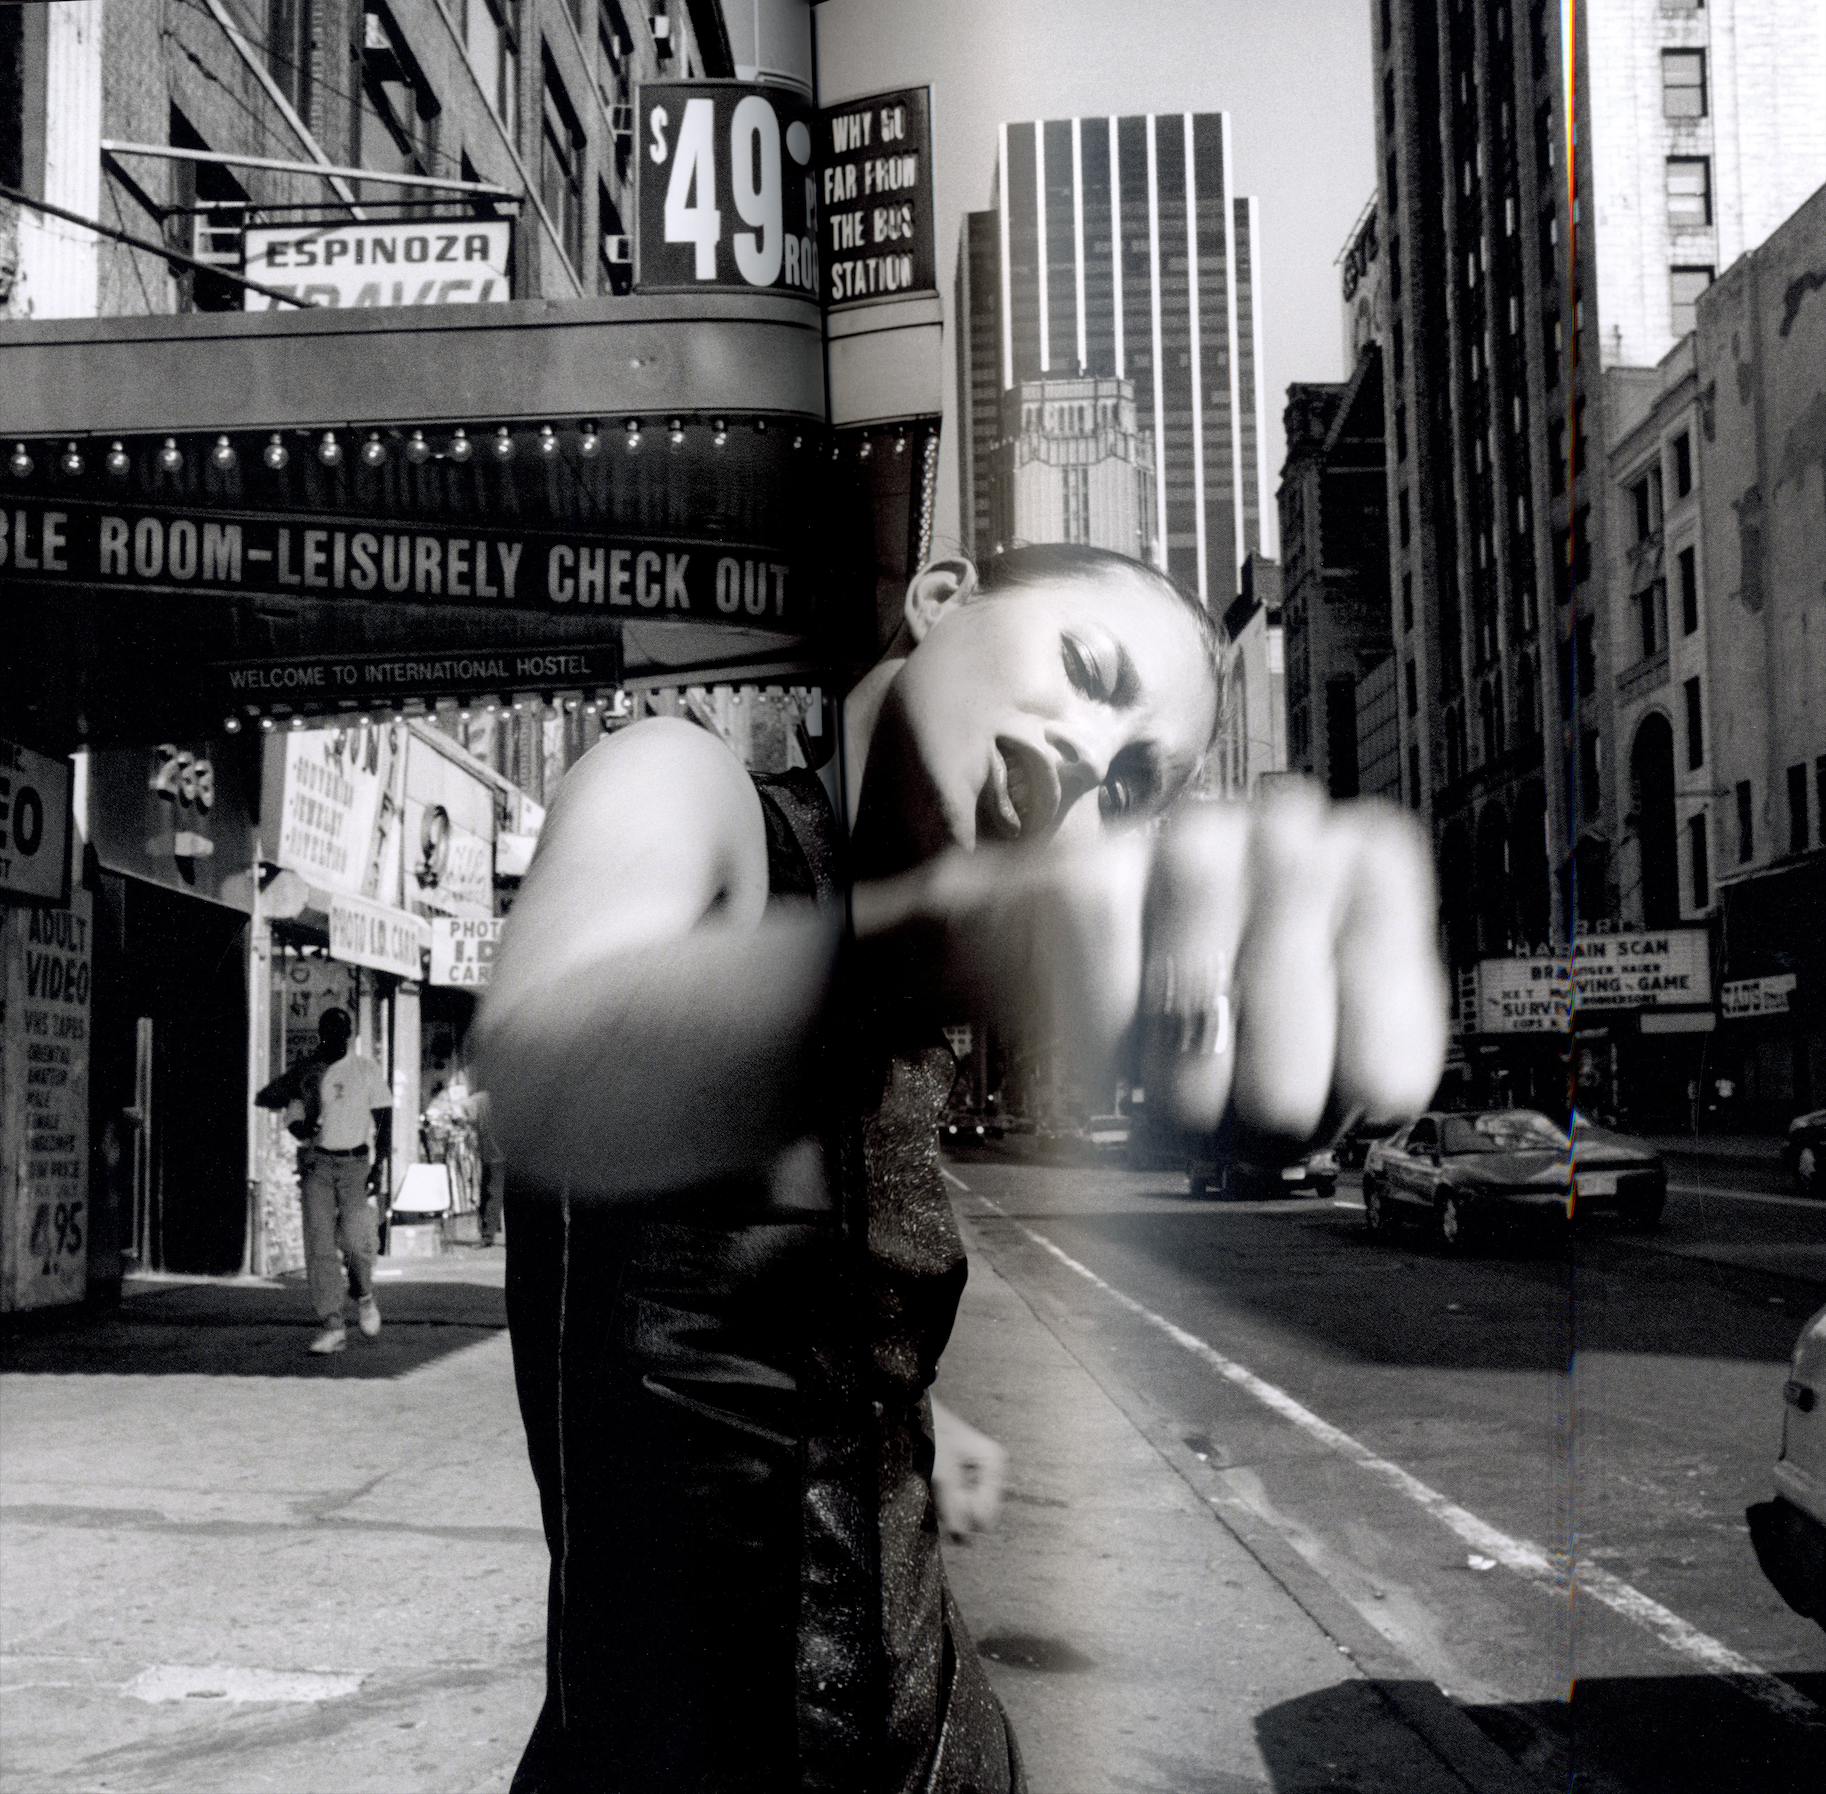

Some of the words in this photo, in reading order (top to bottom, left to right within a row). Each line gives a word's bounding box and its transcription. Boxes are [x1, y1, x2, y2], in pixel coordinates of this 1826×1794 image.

[832, 111, 871, 153] WHY
[824, 164, 857, 205] FAR
[830, 212, 864, 251] THE
[874, 204, 913, 243] BUS
[266, 234, 490, 267] ESPINOZA
[832, 255, 913, 300] STATION
[100, 516, 523, 599] ROOM-LEISURELY
[548, 544, 691, 609] CHECK
[716, 557, 790, 616] OUT
[229, 665, 326, 690] WELCOME
[333, 664, 358, 685] TO
[365, 659, 510, 684] INTERNATIONAL
[516, 655, 593, 677] HOSTEL
[30, 908, 87, 952] ADULT
[450, 921, 501, 937] PHOT
[1618, 940, 1669, 956] SCAN
[27, 951, 89, 1006] VIDEO
[450, 966, 492, 982] CAR
[1637, 975, 1688, 991] GAME
